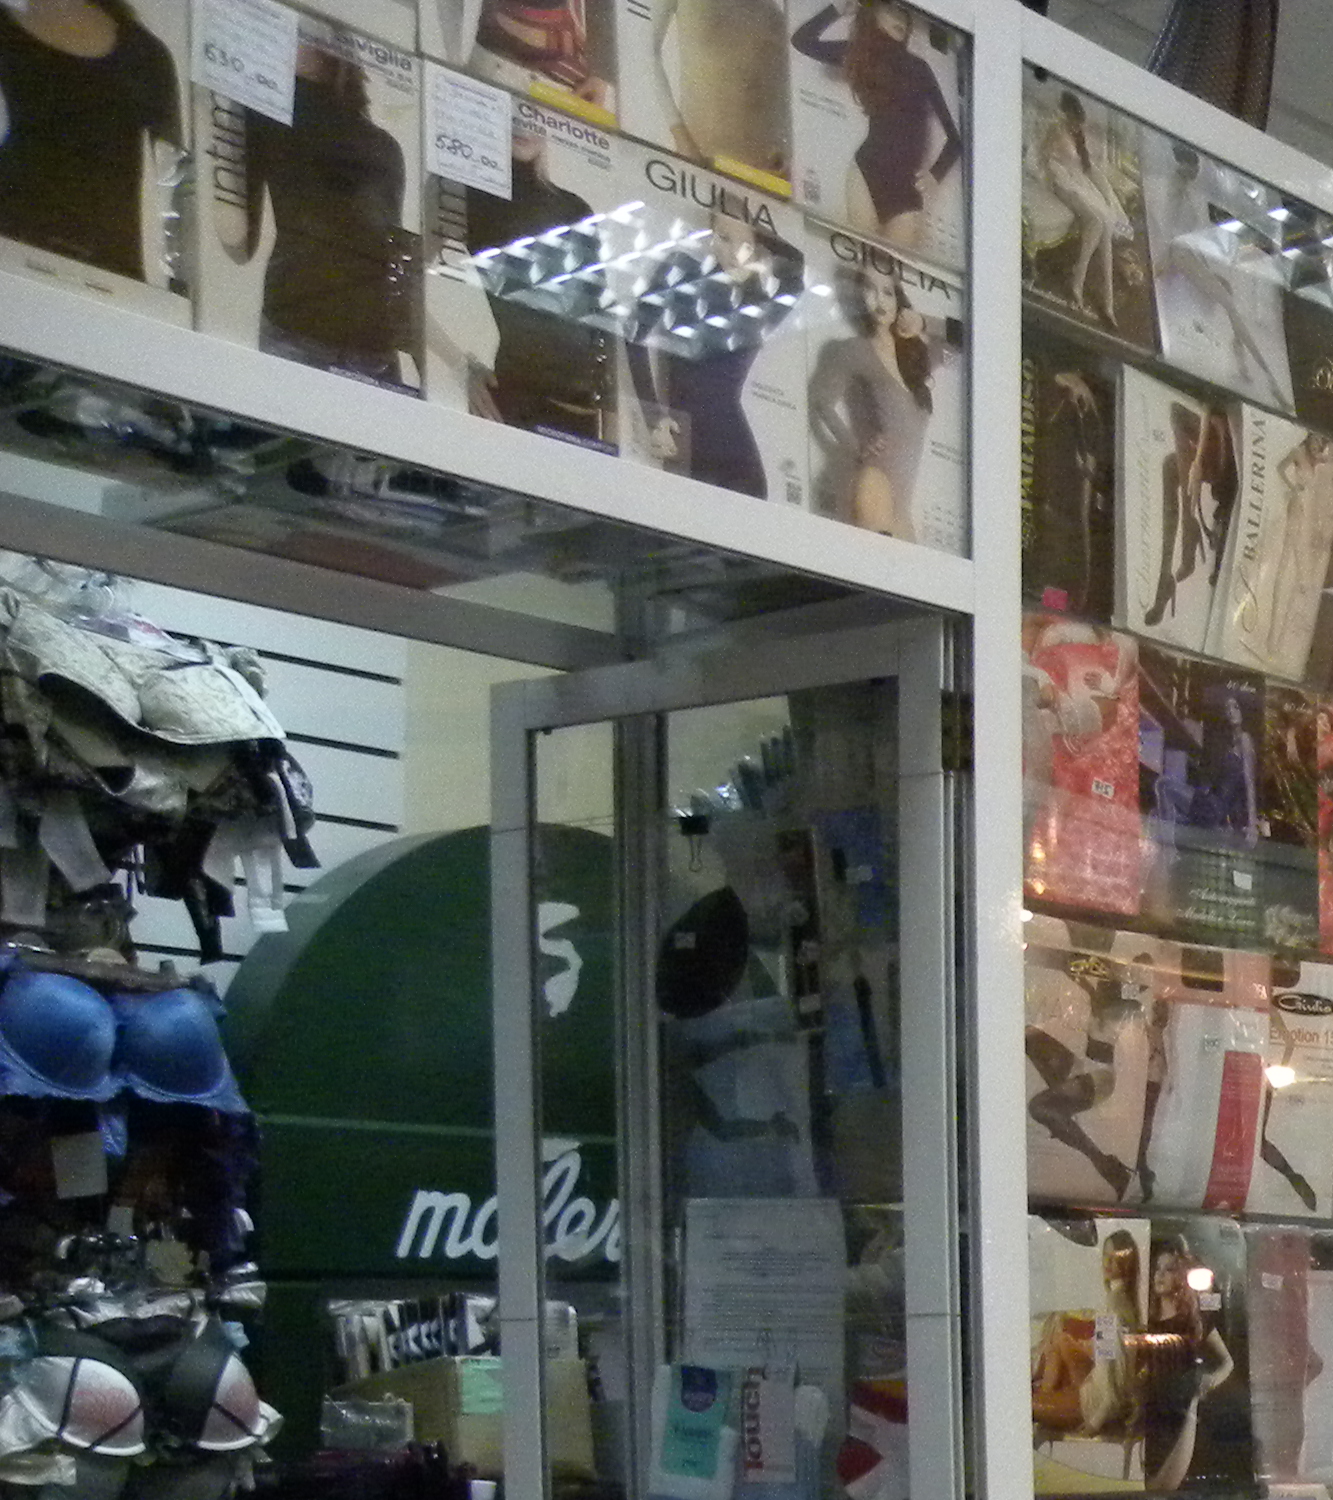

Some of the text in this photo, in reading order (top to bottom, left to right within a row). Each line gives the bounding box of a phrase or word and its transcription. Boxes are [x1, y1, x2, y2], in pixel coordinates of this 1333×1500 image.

[518, 101, 611, 150] Charlotte
[644, 159, 778, 235] GIULIA
[829, 232, 951, 300] GIULIA
[1242, 417, 1267, 563] BALLERINA
